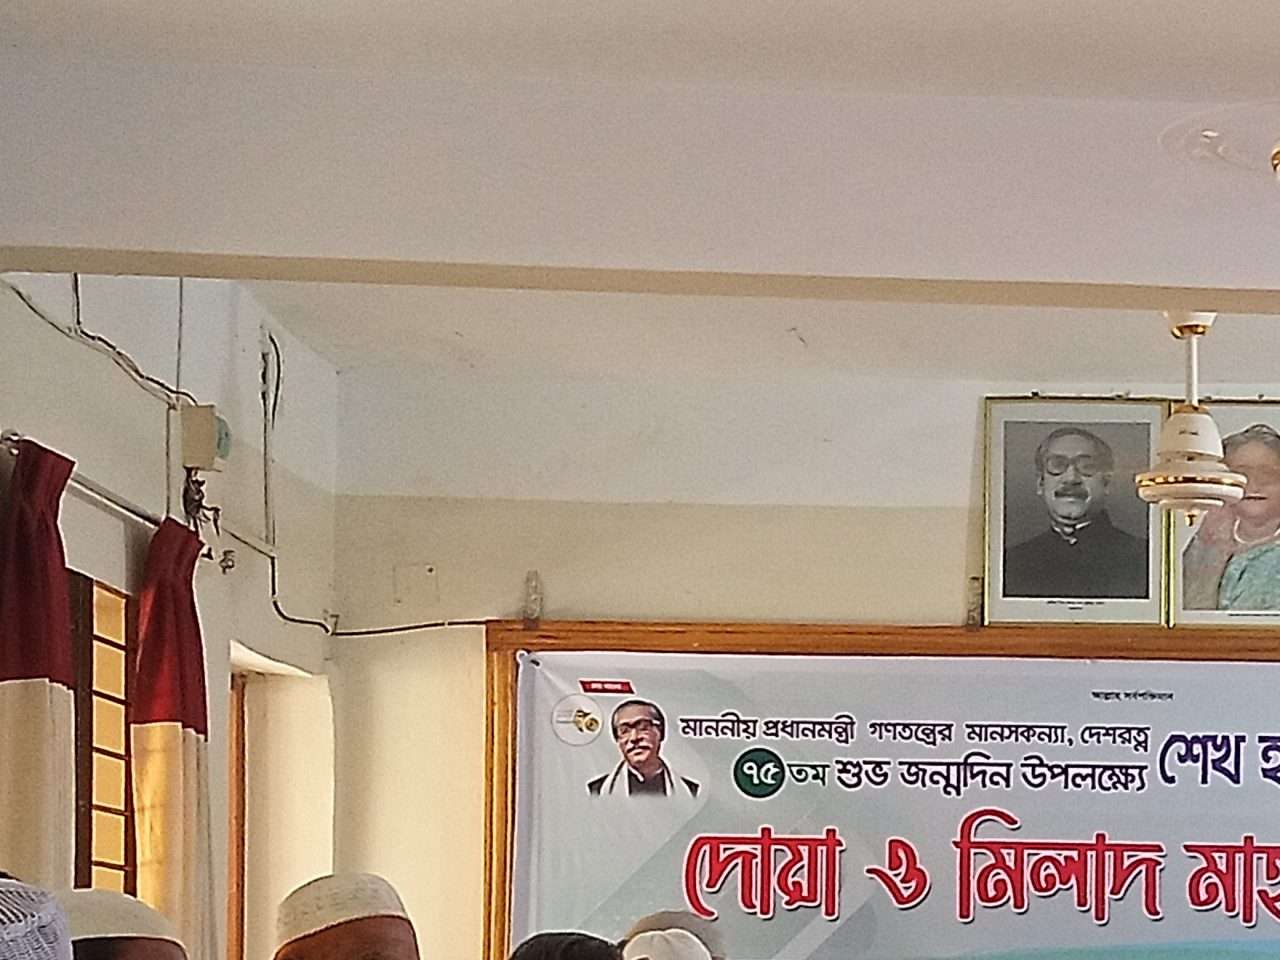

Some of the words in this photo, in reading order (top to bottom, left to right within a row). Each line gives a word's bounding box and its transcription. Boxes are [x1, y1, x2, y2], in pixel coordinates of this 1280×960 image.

[679, 711, 759, 740] মাননীয়
[762, 713, 856, 745] প্রধানমন্ত্রী
[869, 721, 954, 746] গণতন্ত্রের
[964, 723, 1074, 747] মানসকন্যা,
[1080, 725, 1151, 752] দেশরত্ন
[835, 759, 892, 790] শুভ
[898, 751, 1013, 797] জন্মদিন
[1020, 754, 1149, 792] উপলক্ষ্যে
[1158, 730, 1246, 787] শেখ
[683, 826, 842, 920] দোয়া
[866, 837, 930, 907] ও
[952, 807, 1167, 924] মিলাদ
